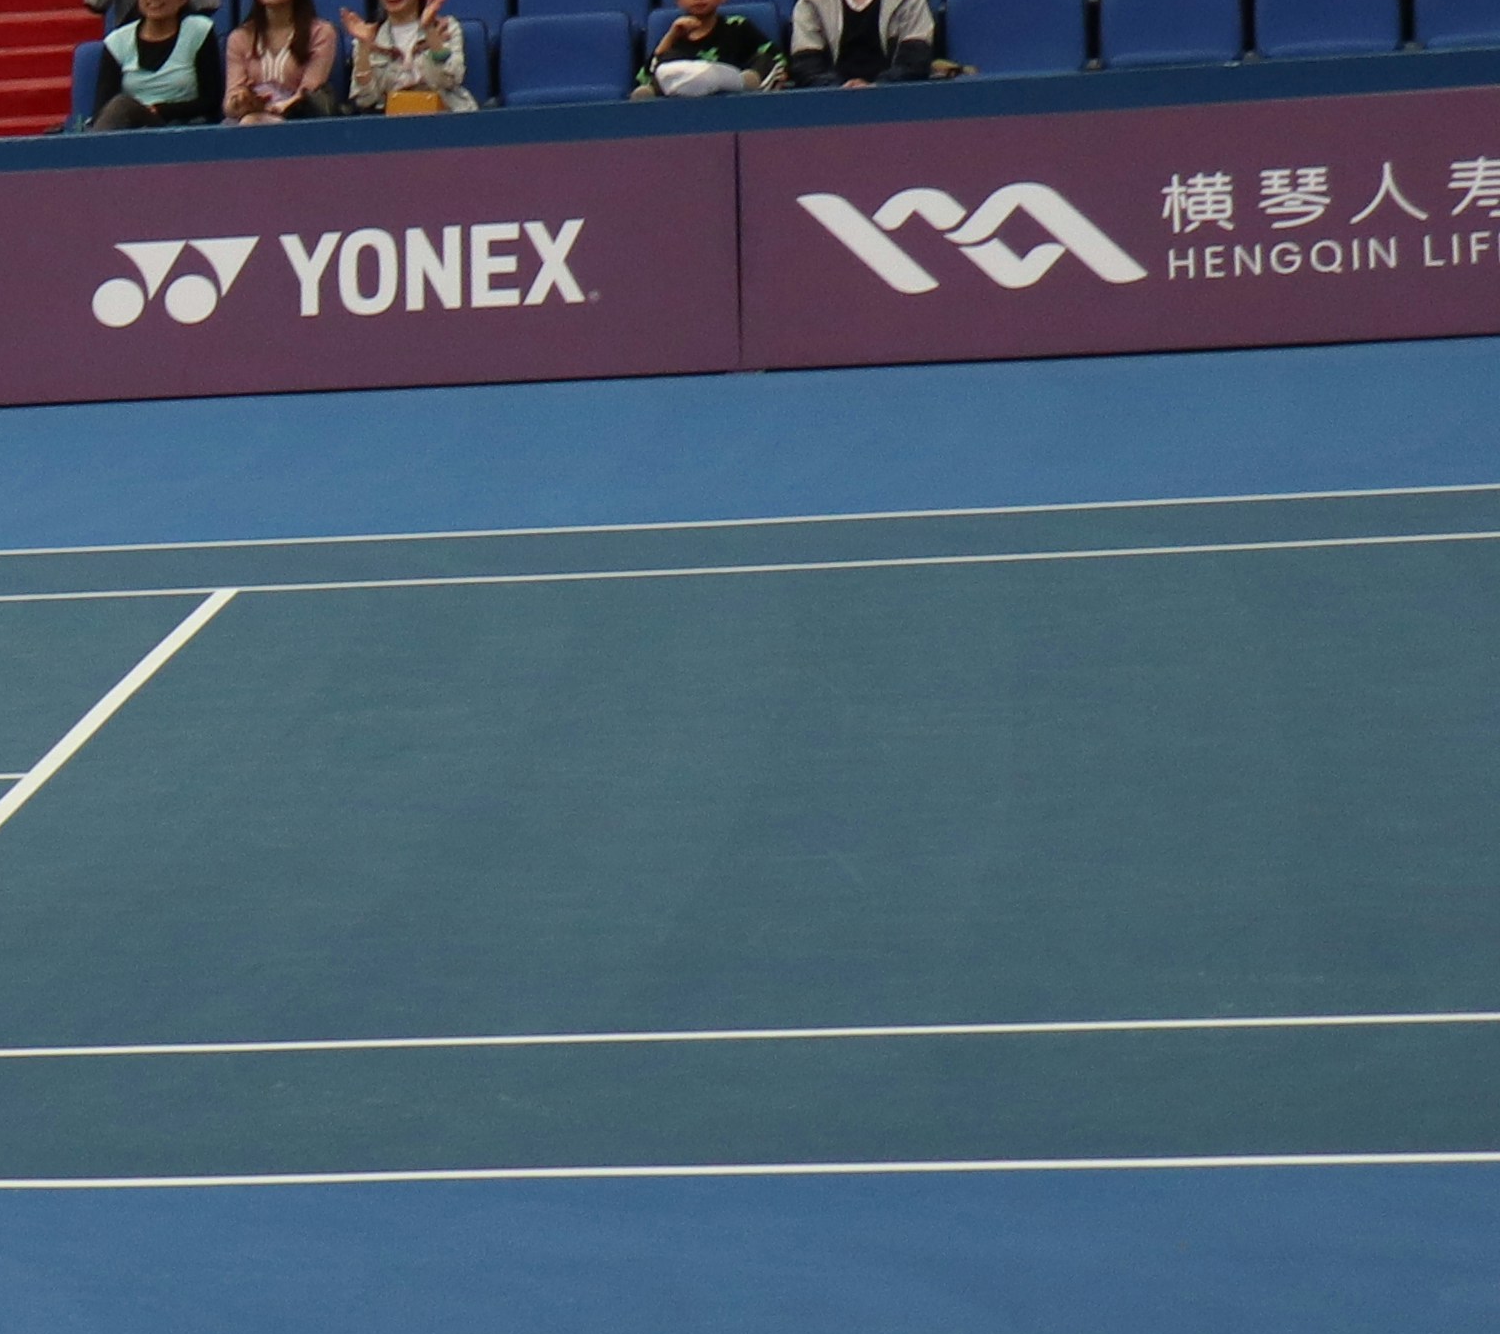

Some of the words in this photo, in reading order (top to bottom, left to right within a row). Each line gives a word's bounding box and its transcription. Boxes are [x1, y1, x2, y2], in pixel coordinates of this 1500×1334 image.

[1161, 155, 1500, 234] 横琴人寿
[279, 218, 586, 318] YONEX
[1168, 237, 1397, 280] HENGQIN
[1423, 230, 1500, 267] LIF
